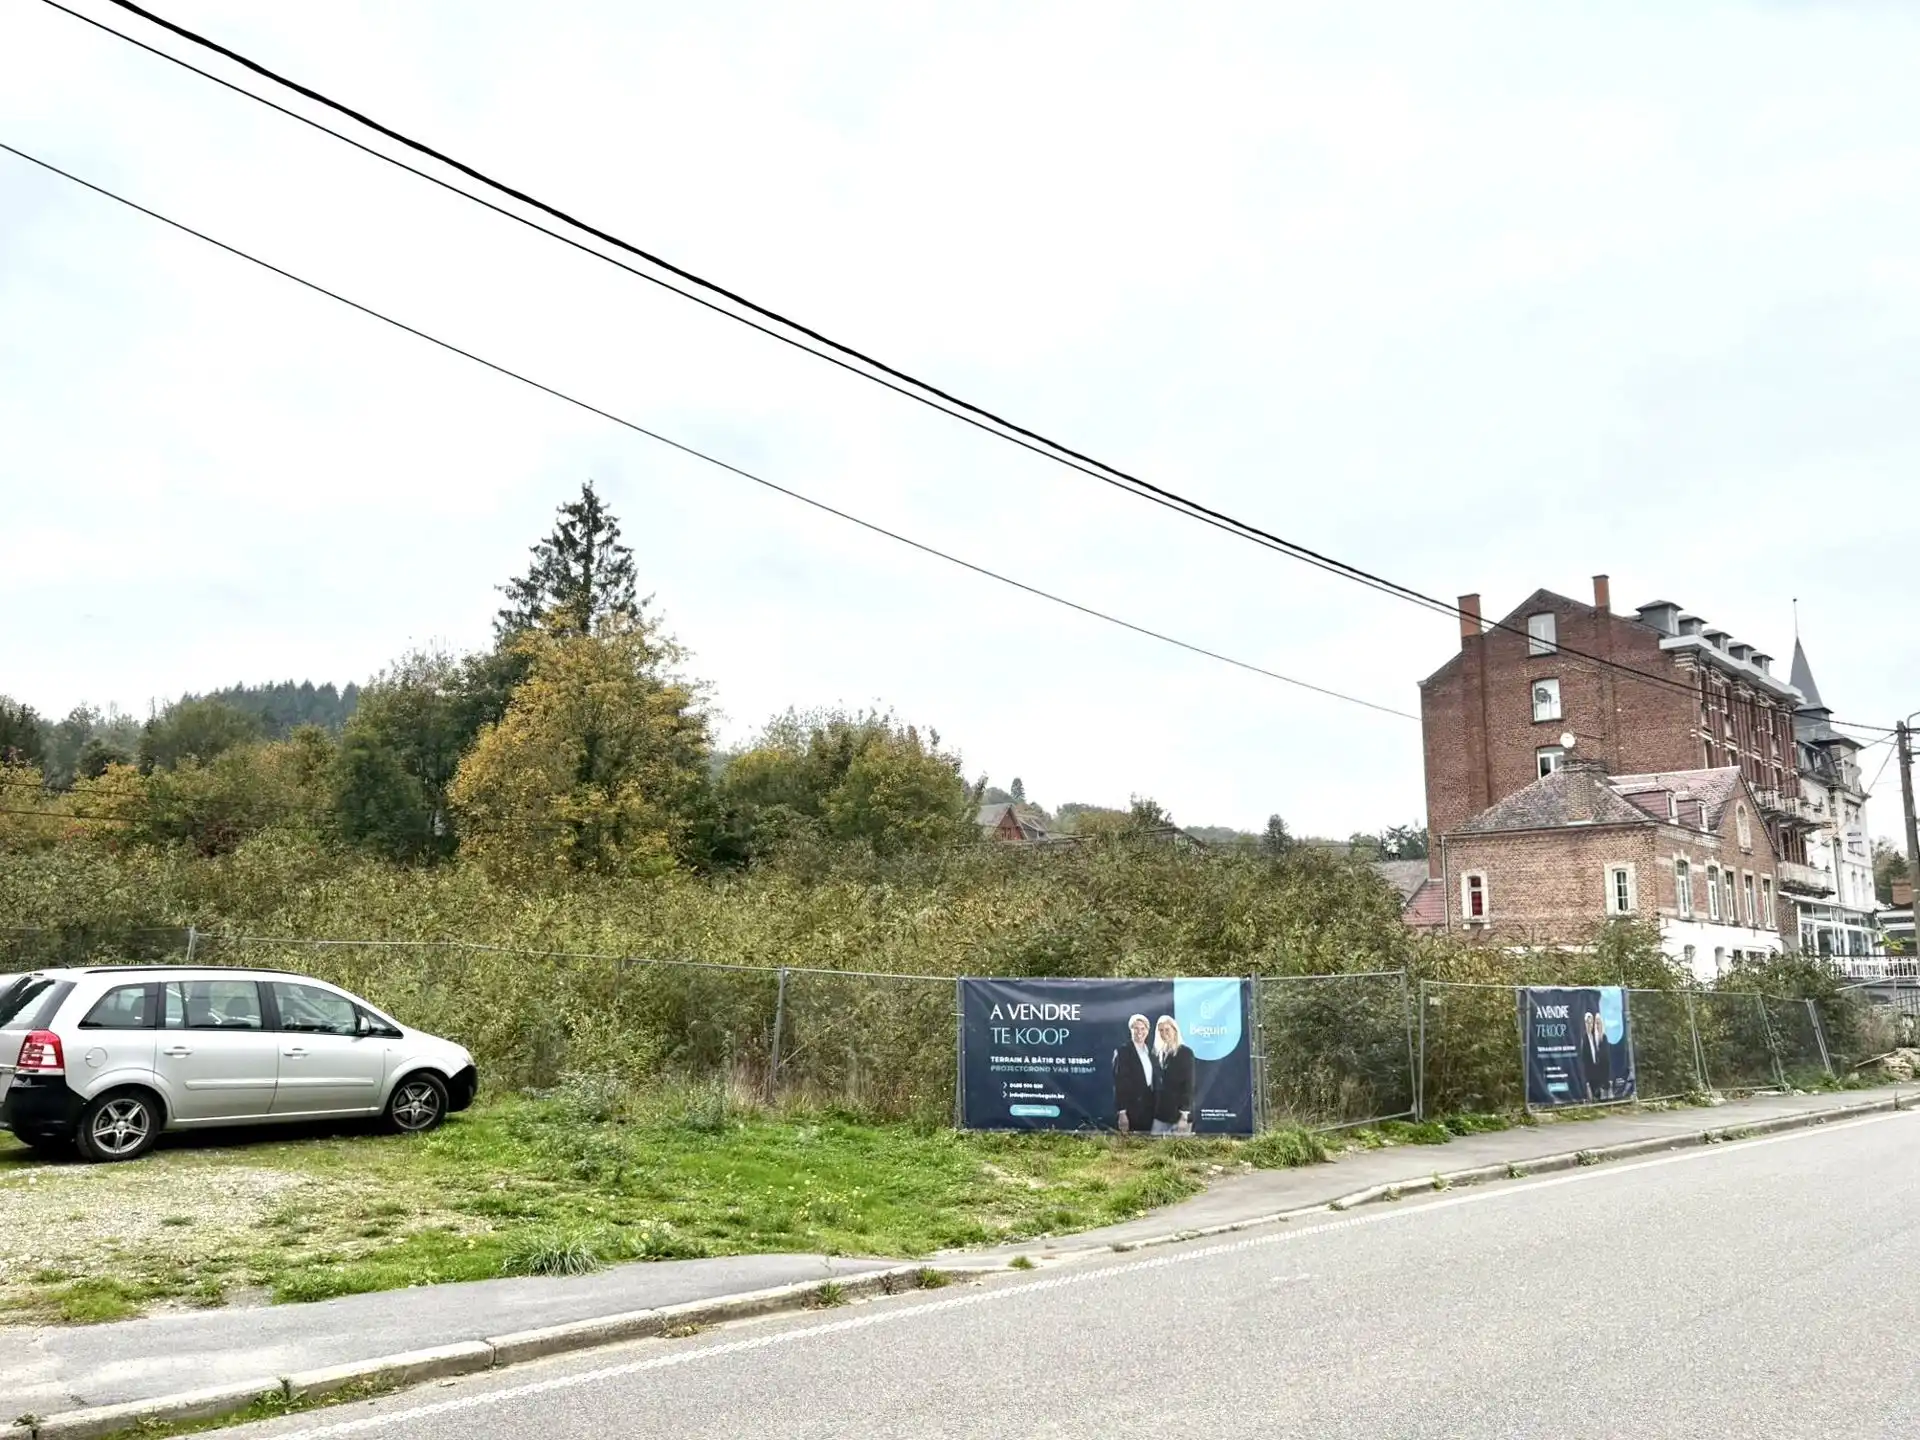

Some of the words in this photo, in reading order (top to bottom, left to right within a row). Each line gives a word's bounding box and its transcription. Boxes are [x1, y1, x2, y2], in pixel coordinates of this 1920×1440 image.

[990, 1003, 1004, 1020] A
[1007, 1003, 1081, 1020] VENDRE
[990, 1027, 1011, 1044] TE
[1015, 1027, 1070, 1045] KOOP
[1190, 1022, 1227, 1038] beguin
[1052, 1065, 1069, 1073] VAN
